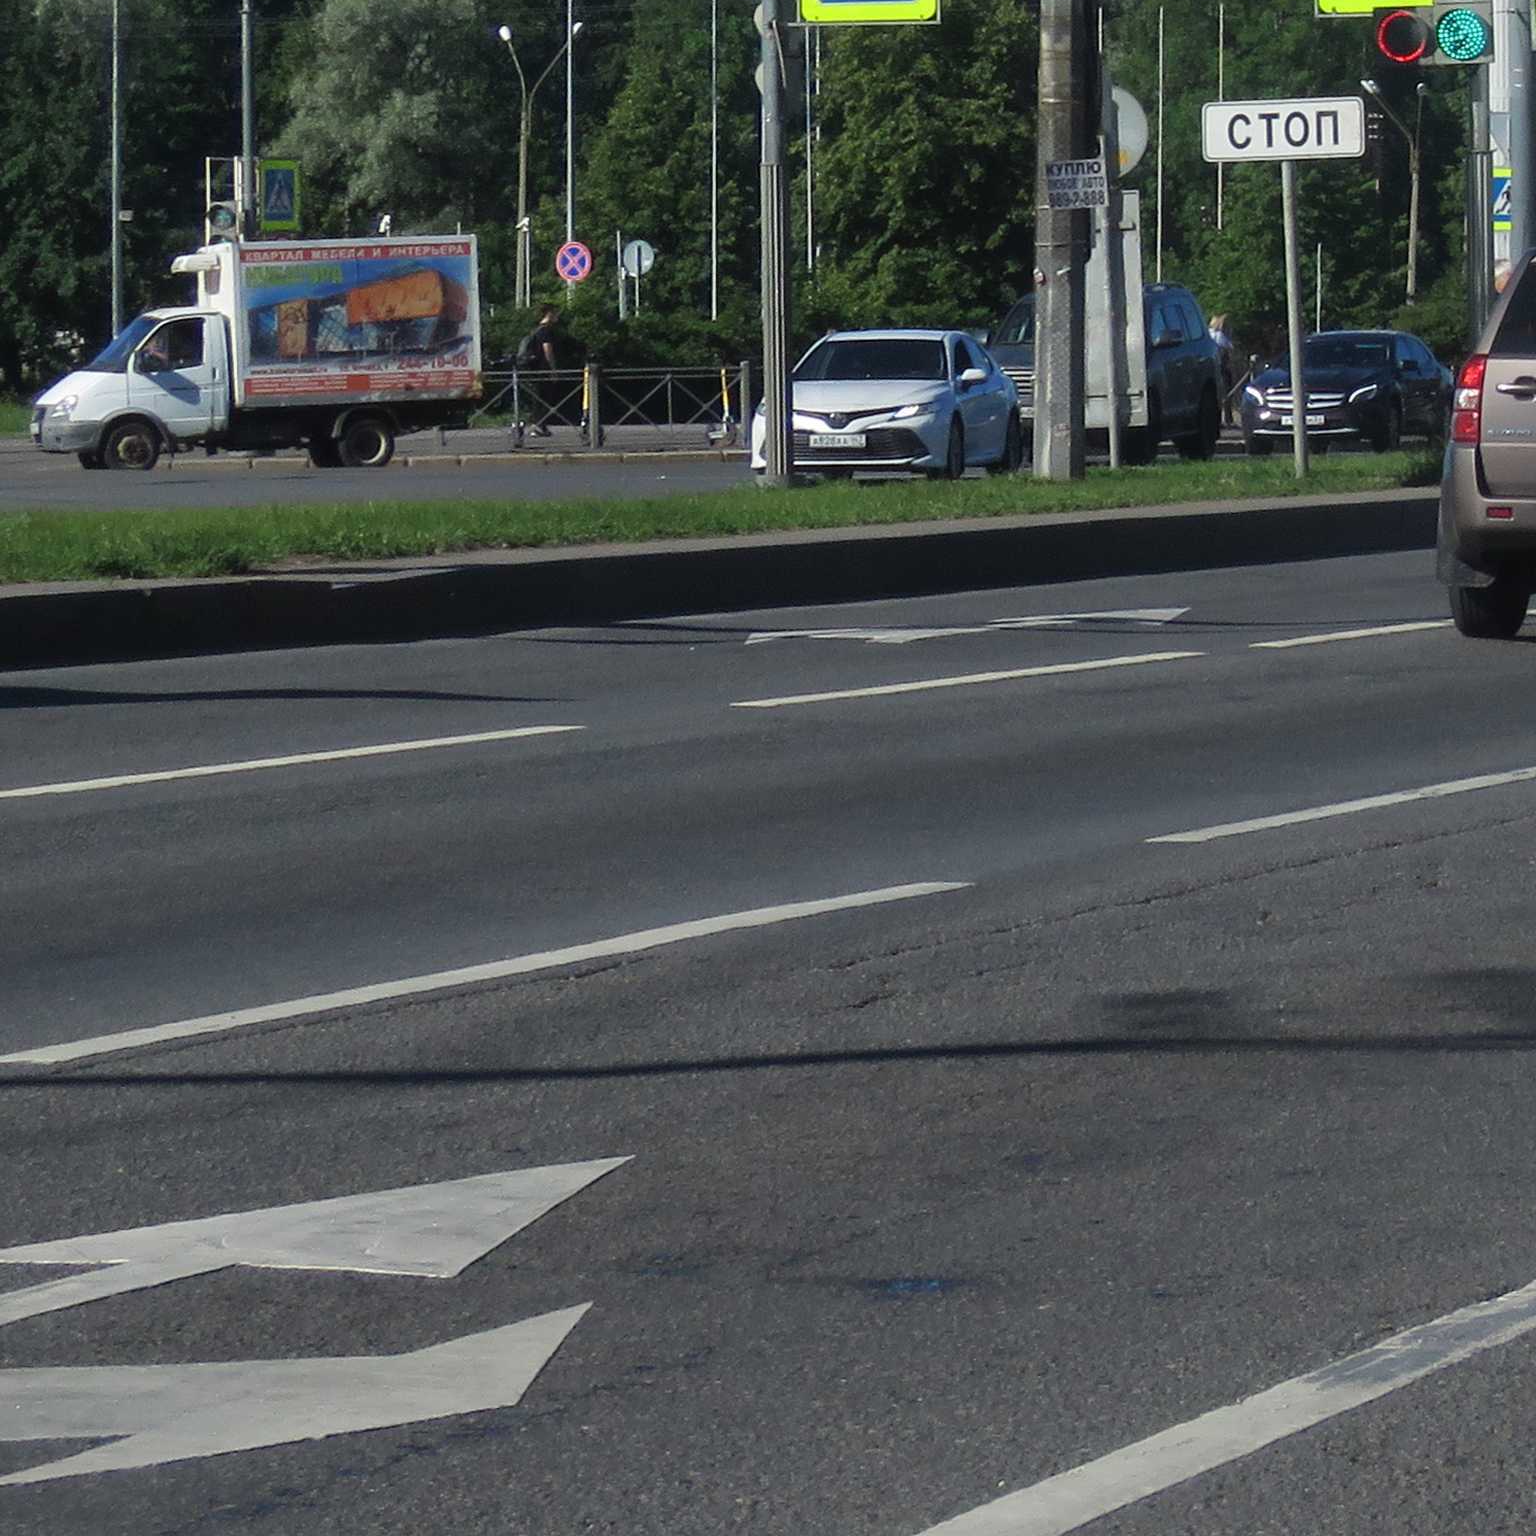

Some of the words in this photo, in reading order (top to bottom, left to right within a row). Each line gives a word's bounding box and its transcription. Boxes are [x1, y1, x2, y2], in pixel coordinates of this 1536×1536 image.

[1227, 110, 1340, 150] СТОП
[1047, 161, 1101, 176] КУПЛЮ
[245, 250, 304, 262] КВАРТАЛ
